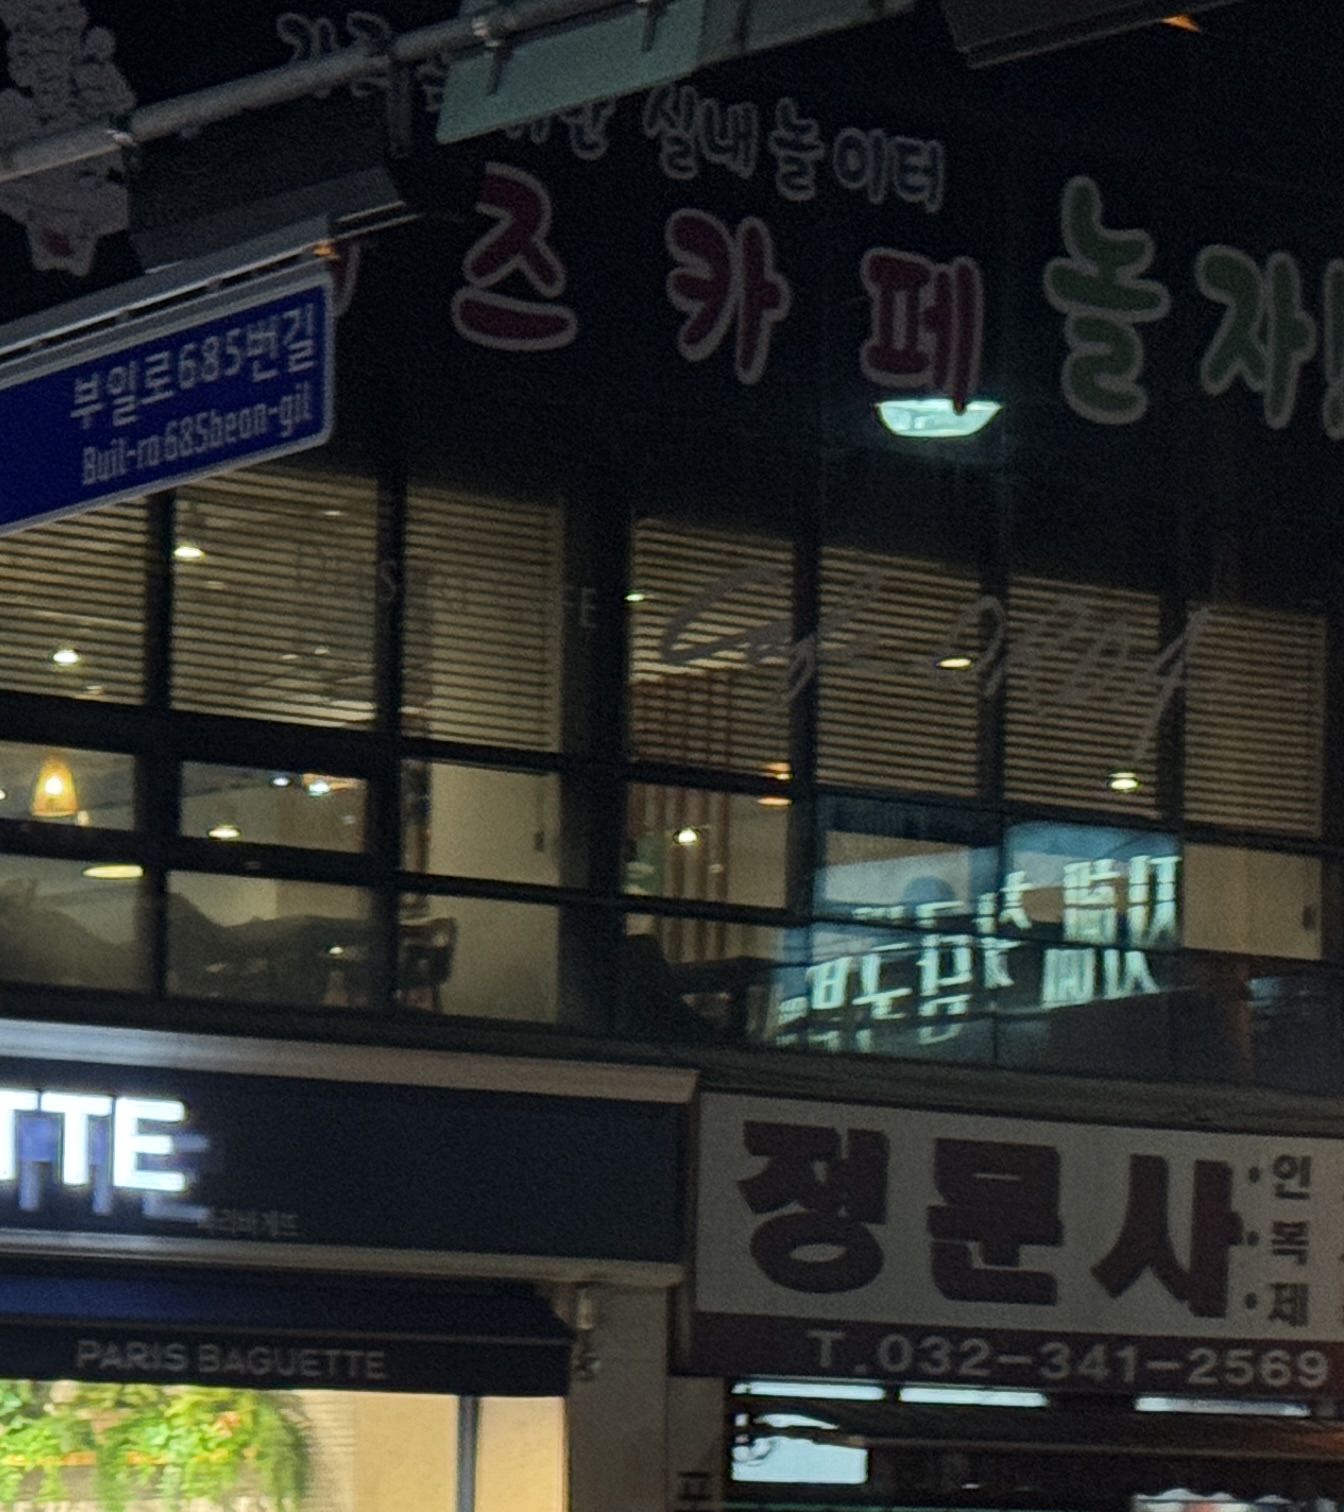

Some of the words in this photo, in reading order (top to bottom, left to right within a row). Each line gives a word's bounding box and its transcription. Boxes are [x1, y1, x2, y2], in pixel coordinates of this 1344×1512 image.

[324, 161, 988, 412] 즈카페
[1043, 173, 1344, 442] 놀자
[69, 302, 315, 431] 부일로685번길
[735, 1119, 1244, 1320] 정문사
[1272, 1154, 1313, 1200] 인
[1271, 1220, 1310, 1267] 복
[75, 1338, 188, 1373] PARIS
[198, 1343, 389, 1381] BAGUETTE
